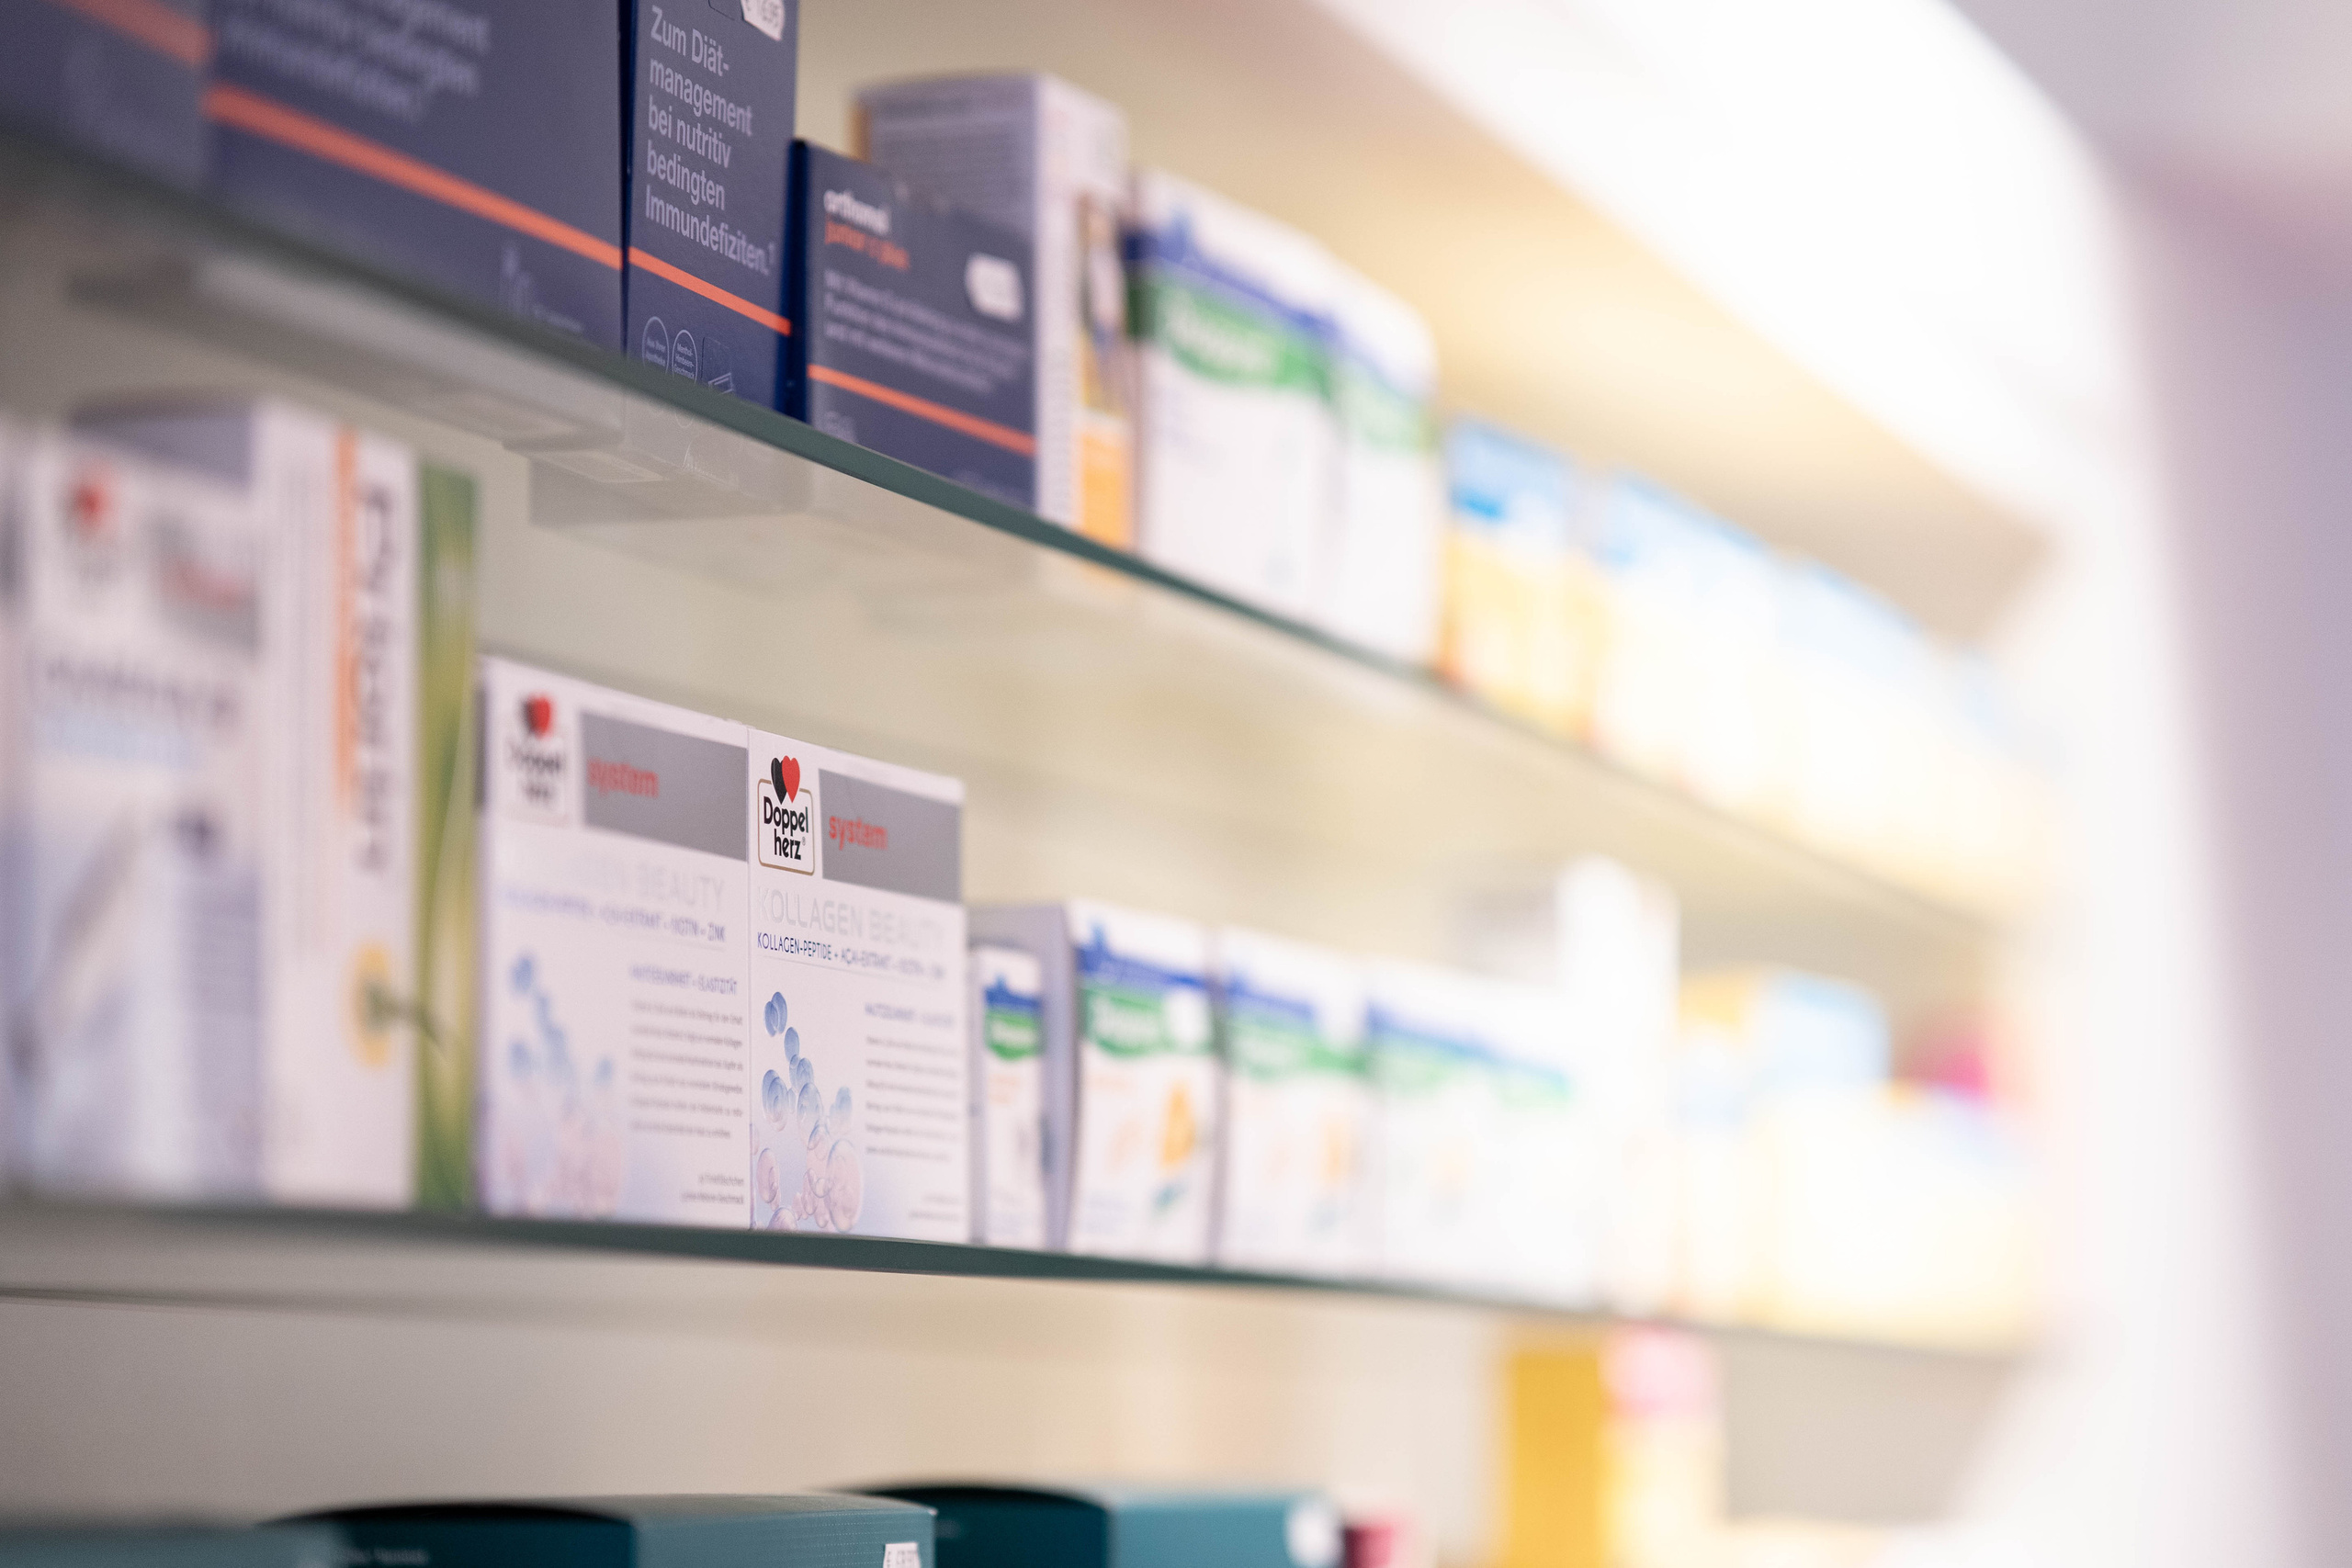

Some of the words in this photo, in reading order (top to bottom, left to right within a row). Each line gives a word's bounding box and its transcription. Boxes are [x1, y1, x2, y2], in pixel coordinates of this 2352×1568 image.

[650, 5, 686, 57] Zum
[691, 28, 729, 77] Diät-
[650, 58, 752, 137] management
[649, 95, 673, 138] bei
[676, 118, 731, 169] nutritiv
[647, 139, 725, 211] bedingten
[586, 756, 660, 799] system
[763, 795, 808, 837] Doppel
[829, 815, 888, 852] system
[758, 886, 862, 939] KOLLAGEN
[757, 931, 831, 961] KOLLAGEN-PEPTIDE
